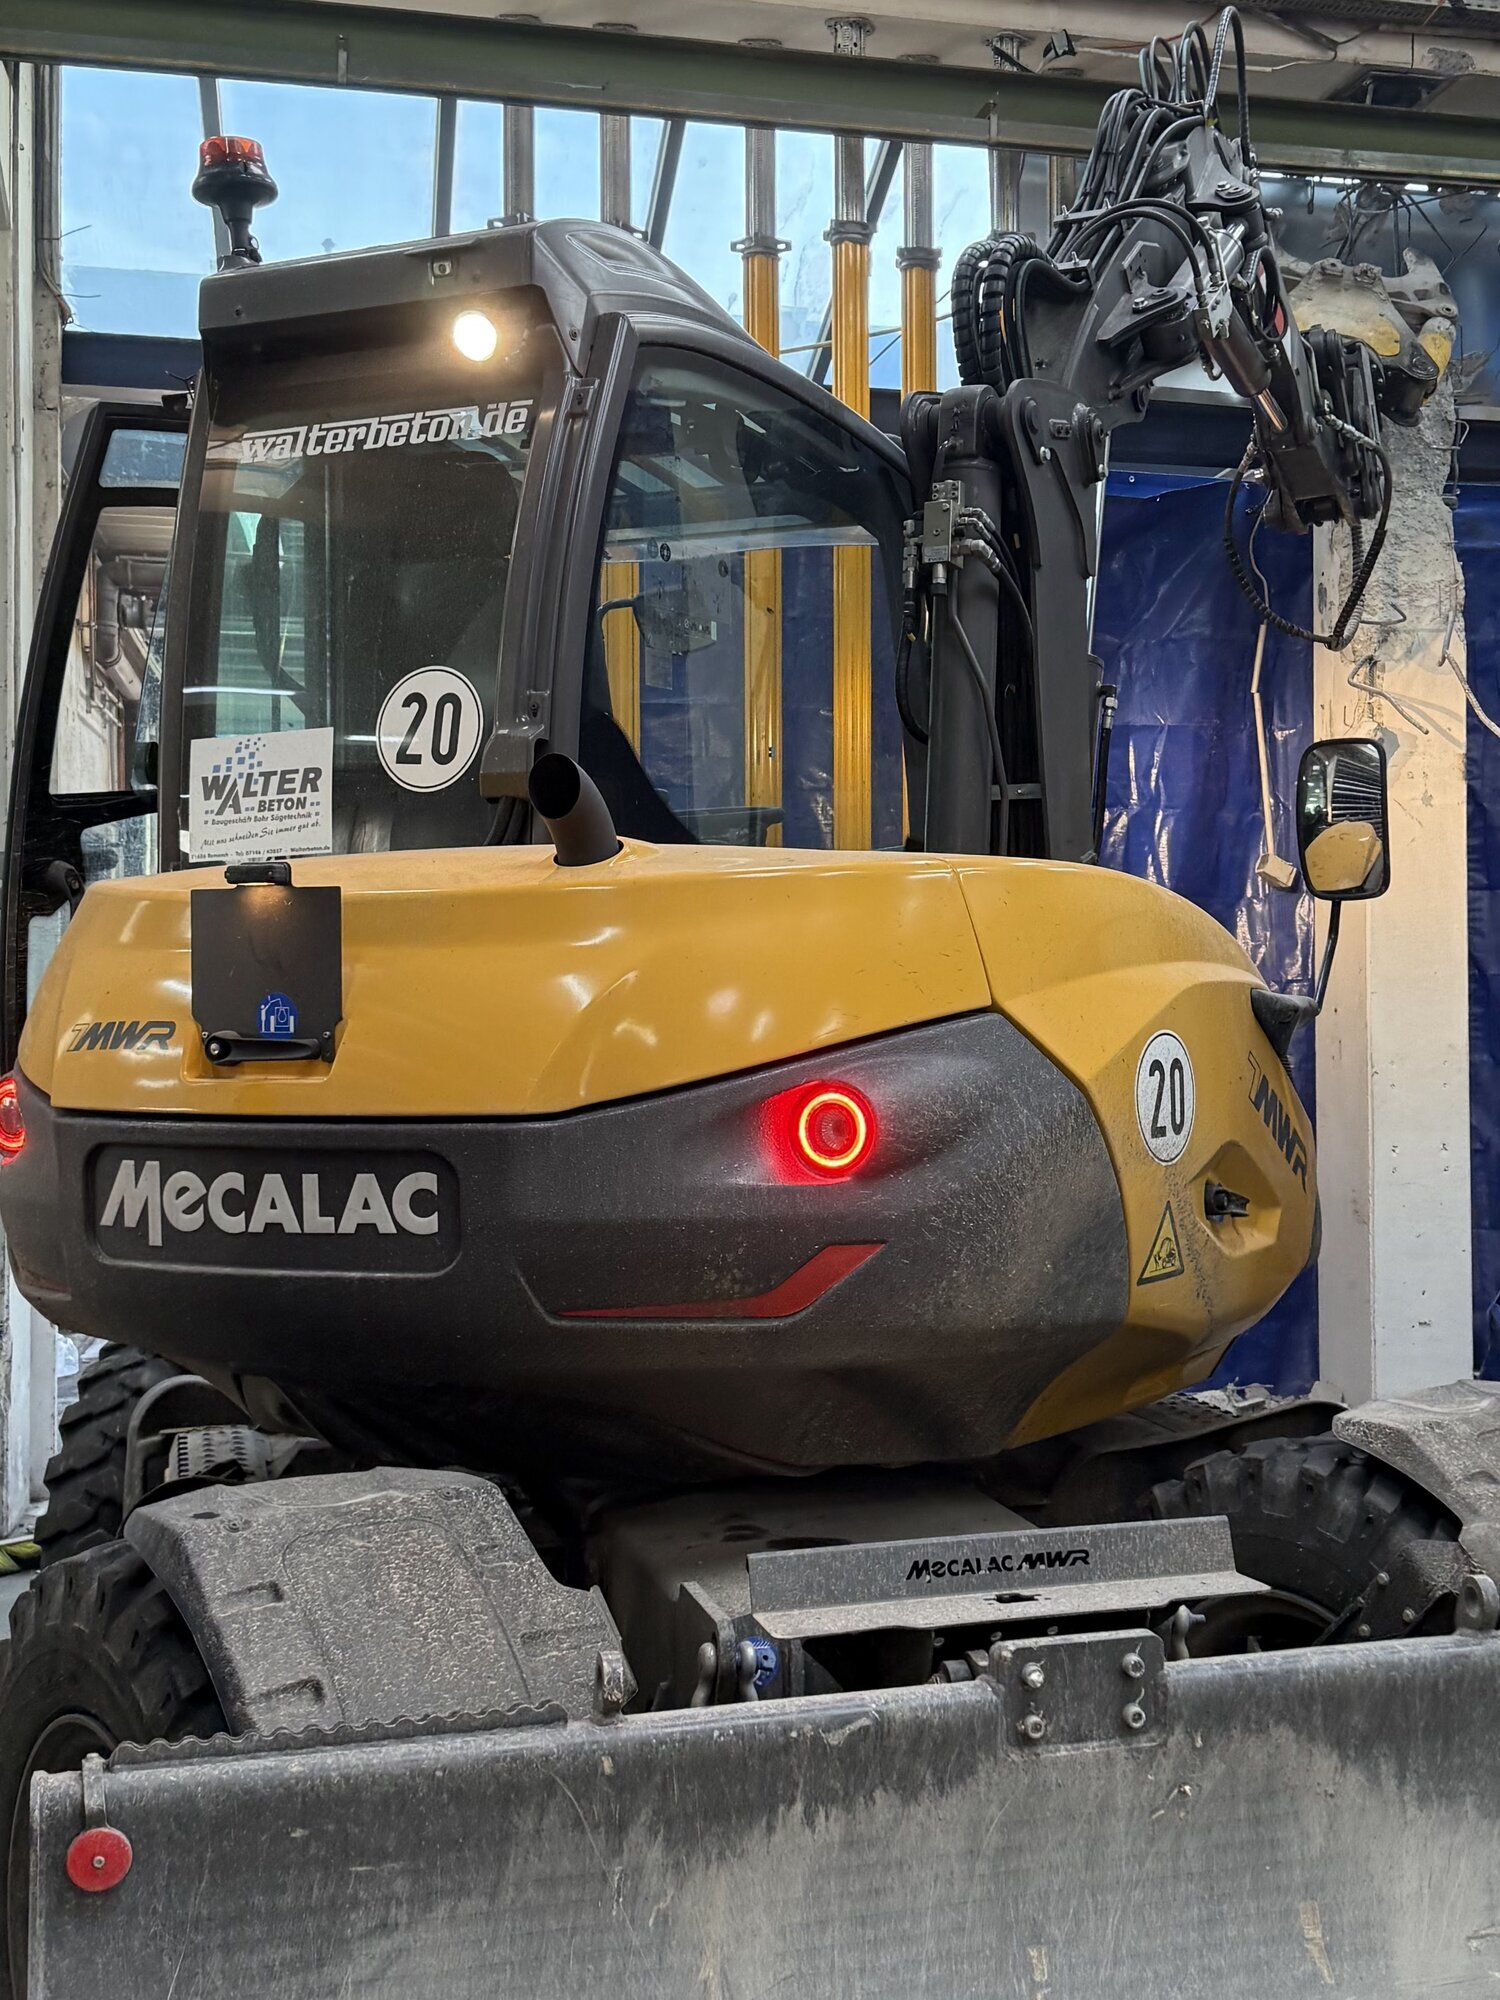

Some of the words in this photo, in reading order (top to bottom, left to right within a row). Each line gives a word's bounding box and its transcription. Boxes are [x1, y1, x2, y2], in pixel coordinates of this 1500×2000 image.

[396, 692, 462, 766] 20
[201, 767, 322, 816] WALTER
[257, 796, 307, 813] BETON
[1149, 1057, 1185, 1139] 20
[1016, 1549, 1091, 1571] MWR
